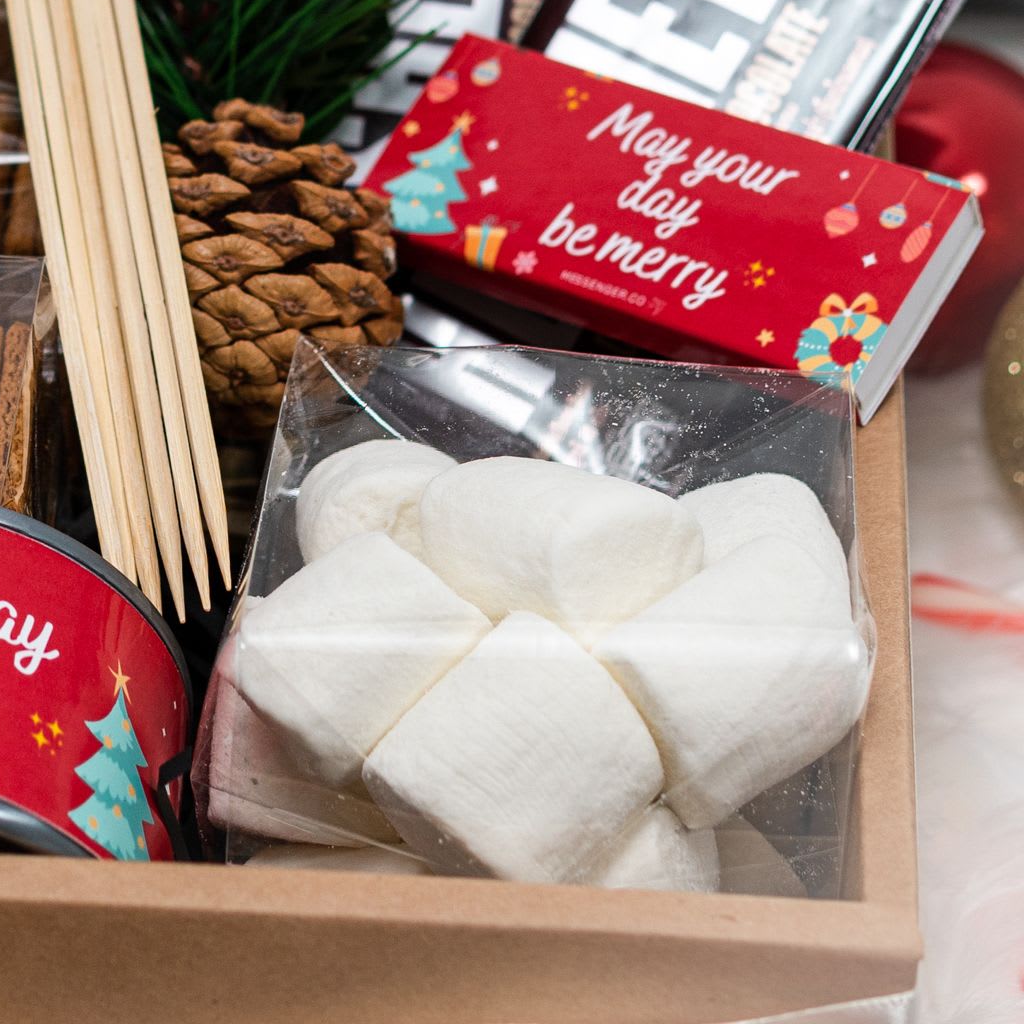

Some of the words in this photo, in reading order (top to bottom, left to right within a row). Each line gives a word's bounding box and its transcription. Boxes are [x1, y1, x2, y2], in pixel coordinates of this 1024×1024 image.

[586, 103, 692, 176] May
[679, 145, 800, 195] your
[617, 174, 703, 239] day
[538, 202, 598, 256] be
[593, 232, 729, 310] merry
